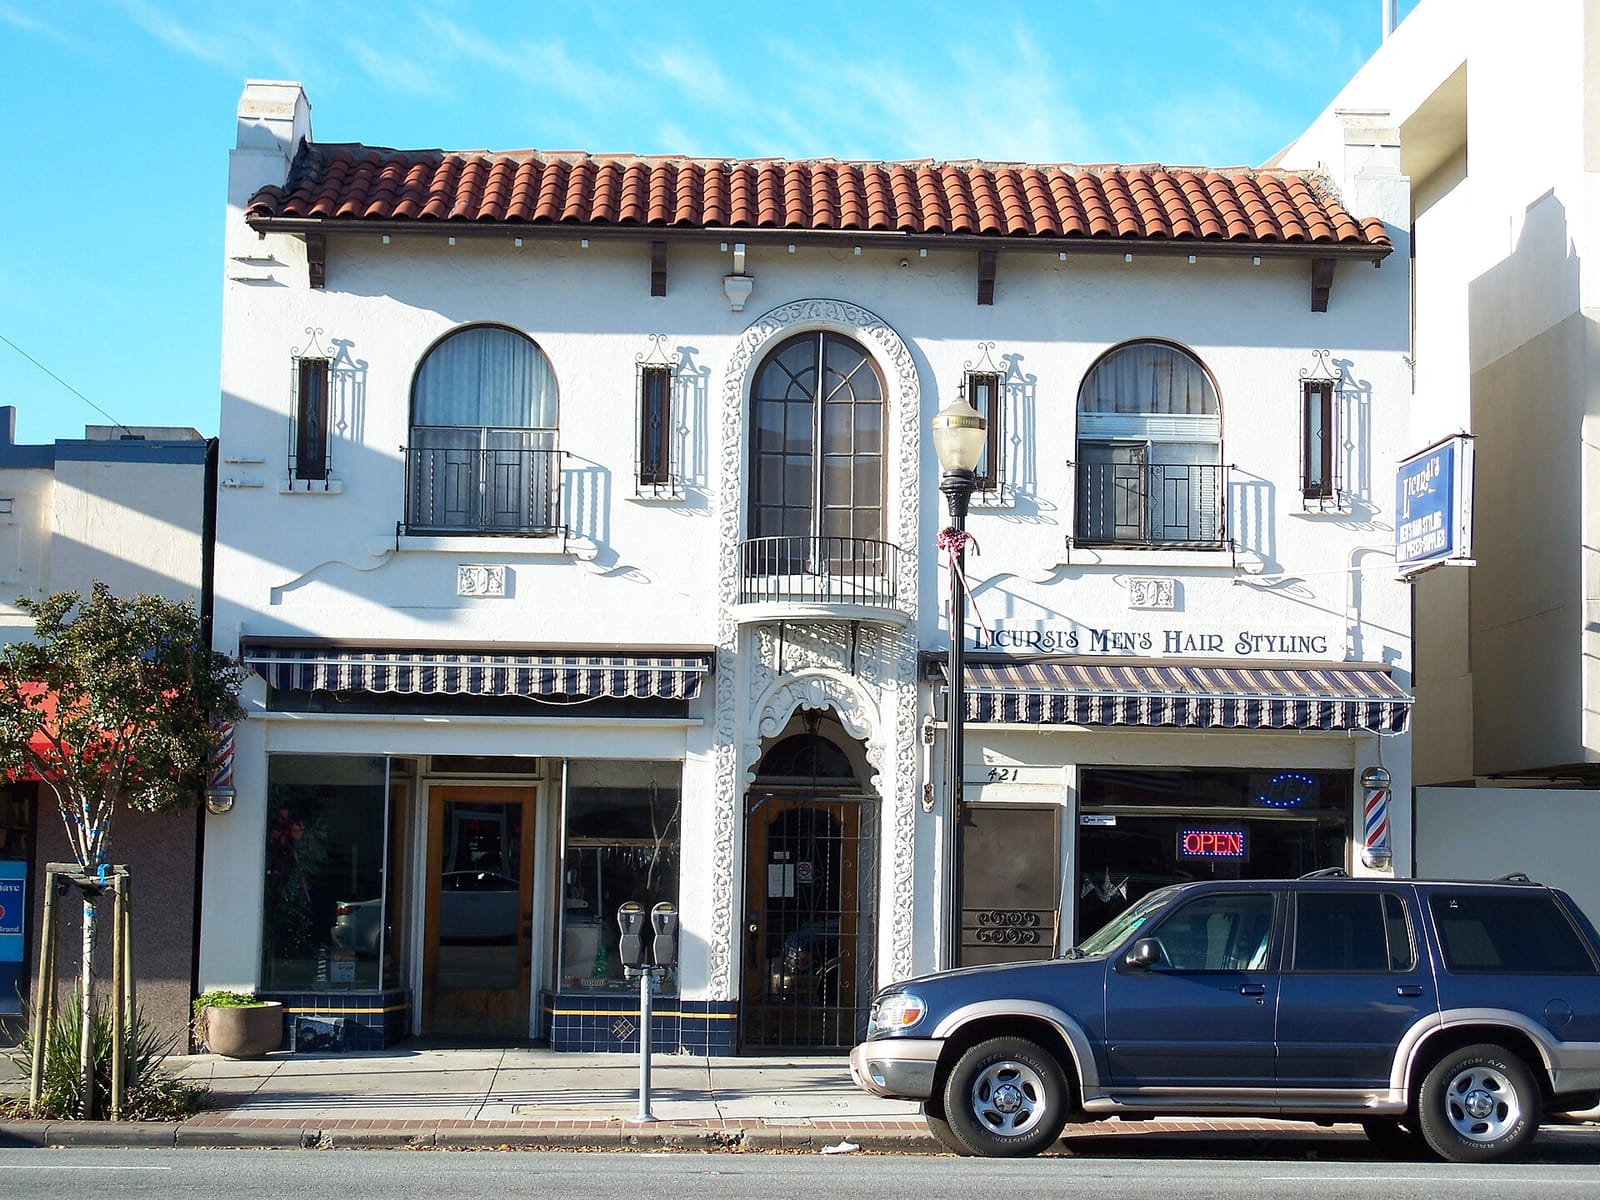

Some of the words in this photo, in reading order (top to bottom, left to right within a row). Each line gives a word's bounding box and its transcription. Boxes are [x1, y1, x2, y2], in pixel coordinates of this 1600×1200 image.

[1089, 628, 1153, 652] MEN'S
[1162, 630, 1225, 653] HAIR
[1234, 631, 1328, 655] STYLING
[988, 767, 1019, 782] 421
[1184, 833, 1242, 854] OPEN
